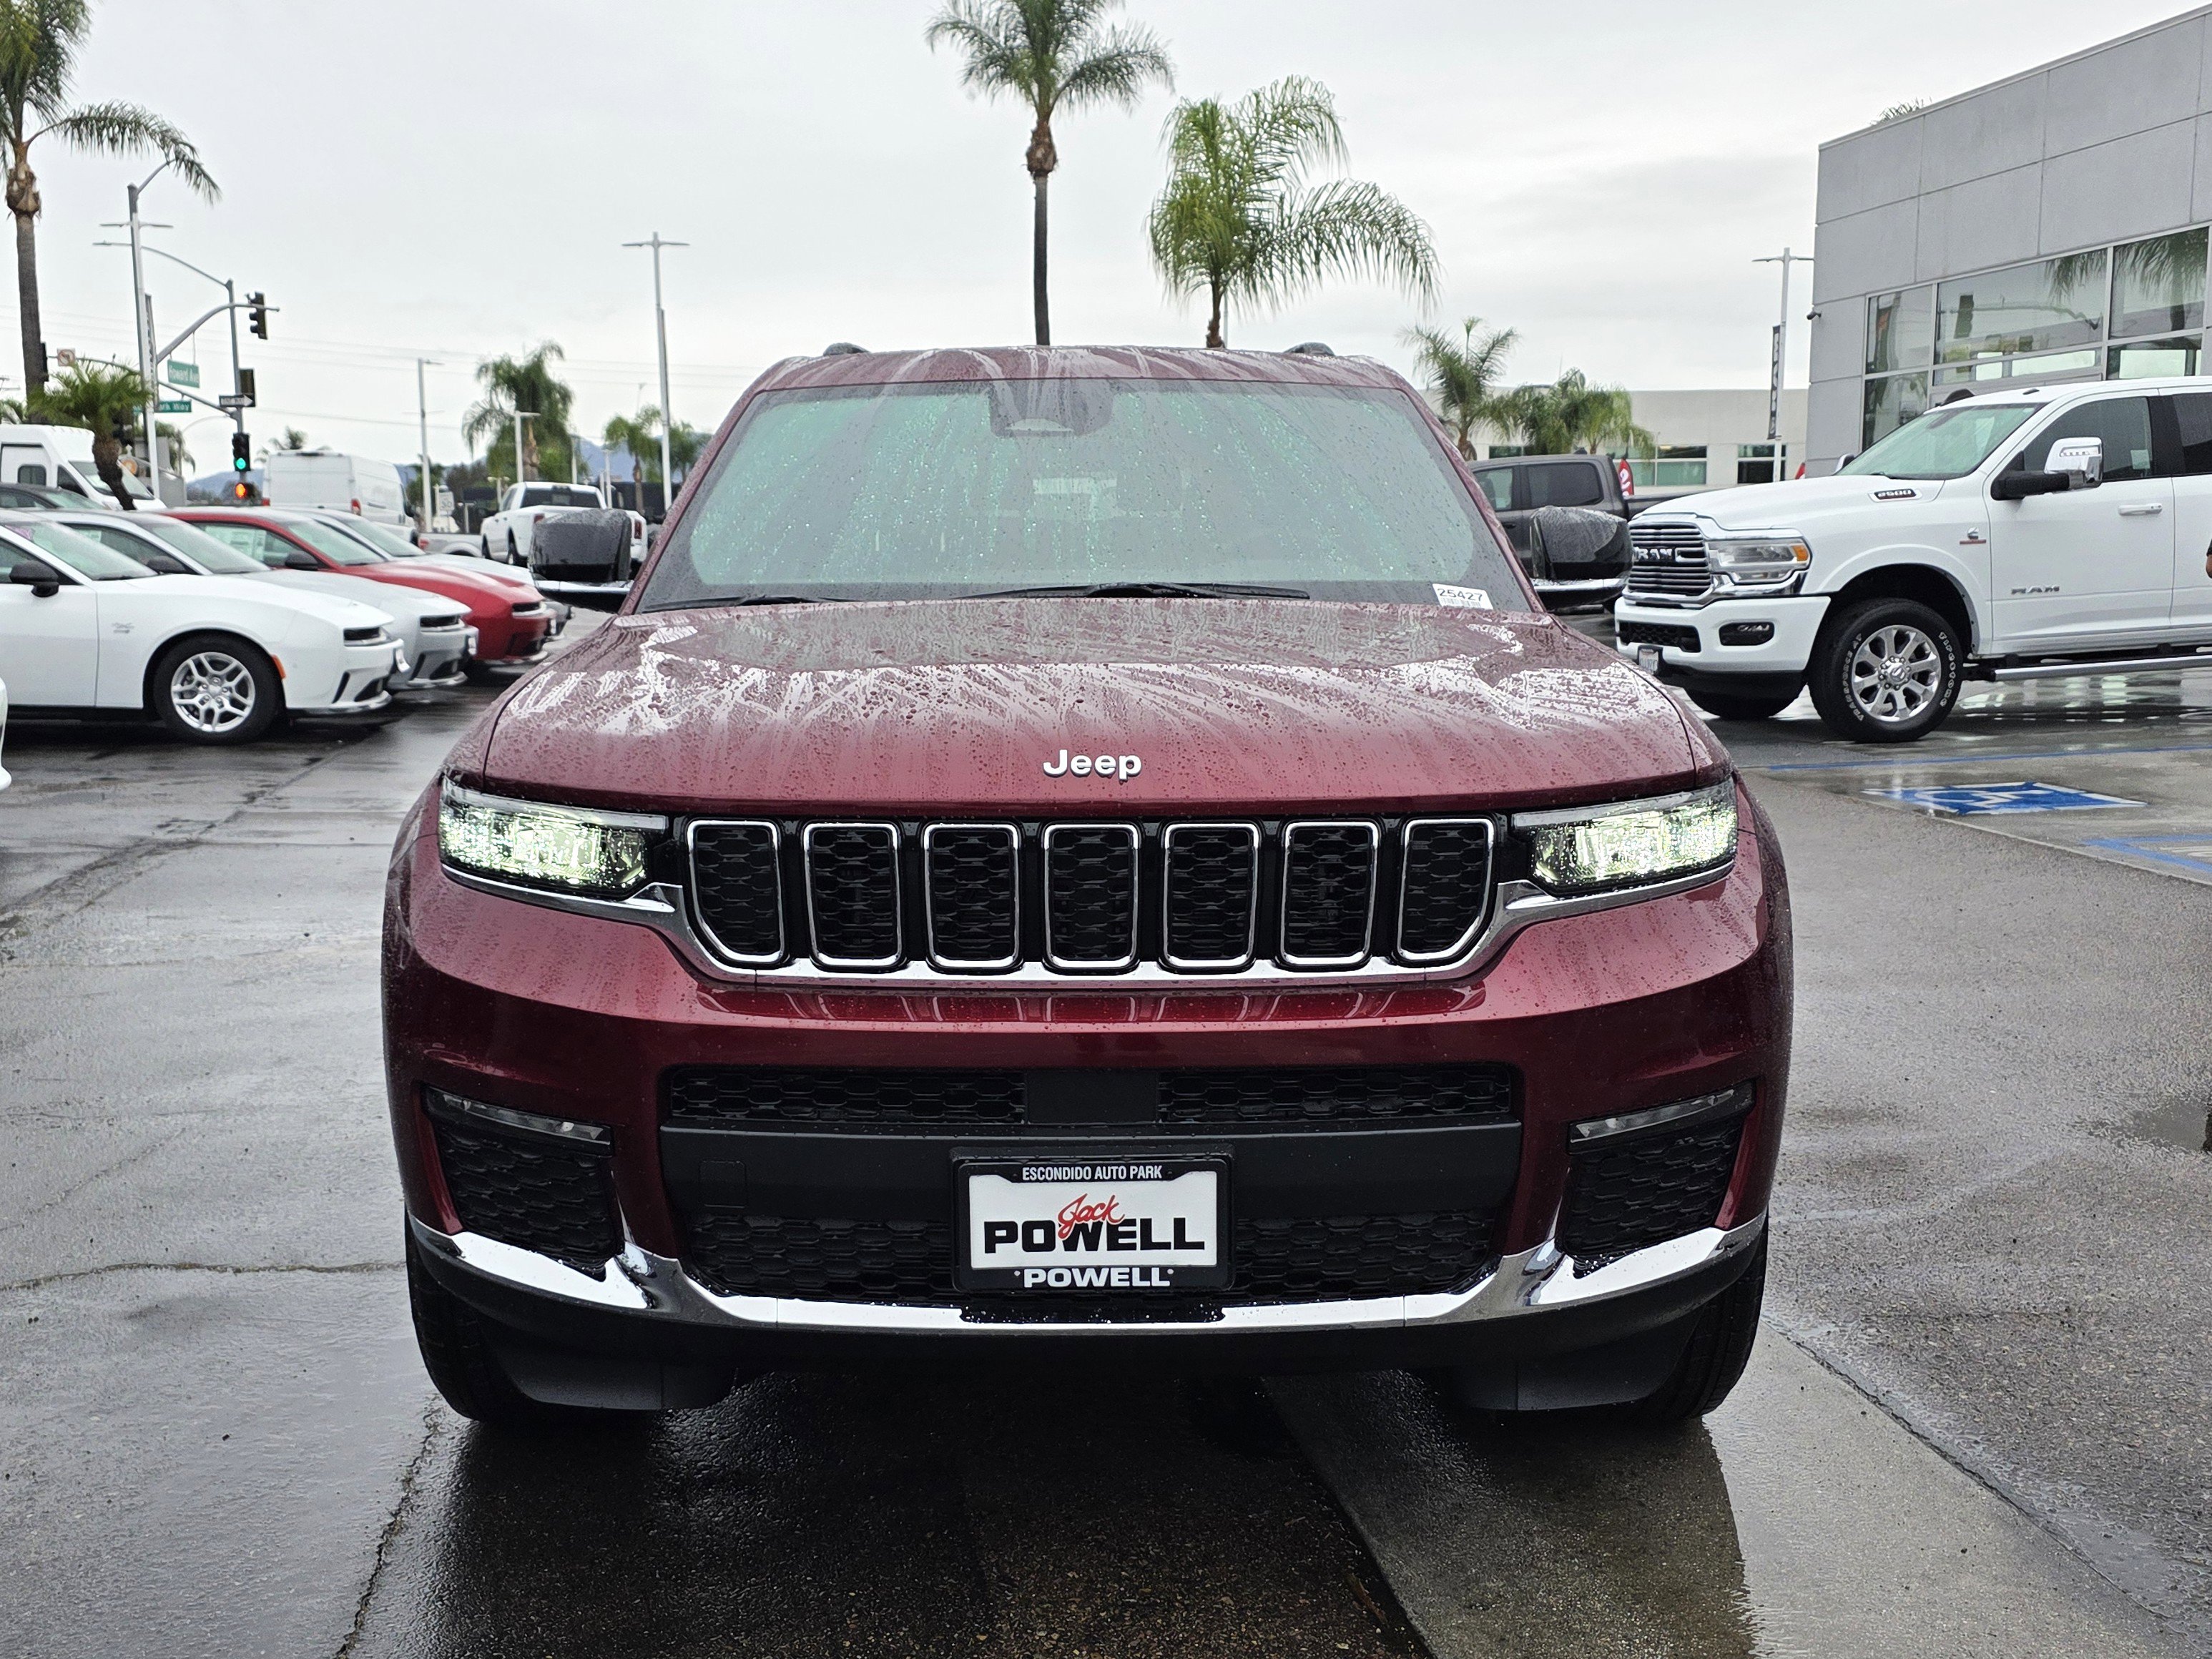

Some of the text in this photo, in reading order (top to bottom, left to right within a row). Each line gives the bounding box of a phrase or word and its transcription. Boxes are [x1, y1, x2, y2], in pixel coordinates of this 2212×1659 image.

[1638, 548, 1673, 560] RAM
[1437, 589, 1483, 601] 25427
[2011, 585, 2060, 595] RAM
[1043, 749, 1142, 779] Jeep
[1022, 1165, 1163, 1181] ESCONDIDO AUTO PARK
[1057, 1193, 1126, 1240] Jack
[983, 1217, 1205, 1254] POWELL
[1023, 1267, 1171, 1288] POWELL
